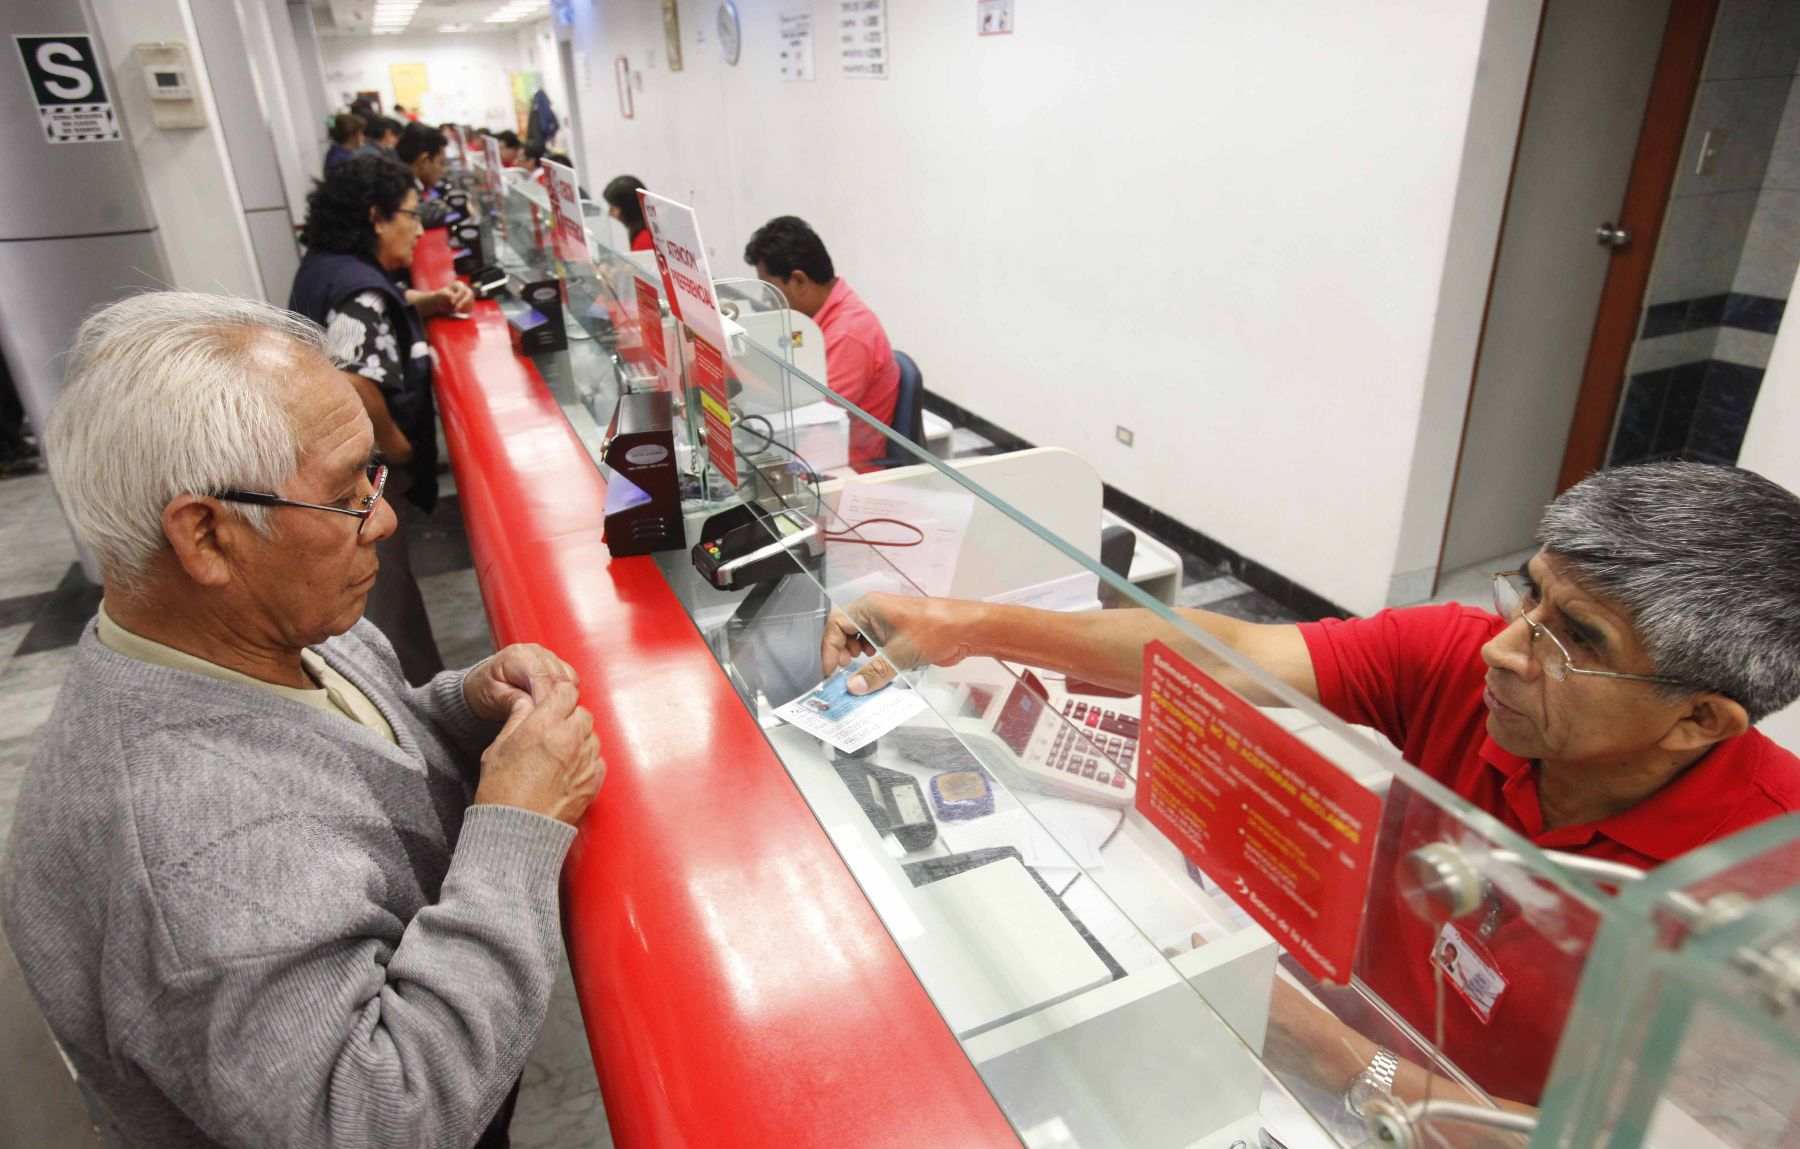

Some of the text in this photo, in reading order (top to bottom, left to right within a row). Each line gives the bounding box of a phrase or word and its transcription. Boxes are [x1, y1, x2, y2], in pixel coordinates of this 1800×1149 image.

[36, 42, 93, 100] S
[1154, 654, 1192, 688] Estimado
[1210, 723, 1223, 739] NO
[1226, 735, 1237, 750] SE
[1300, 792, 1361, 844] RECLAMOS
[1249, 891, 1278, 921] Banco
[1277, 918, 1290, 933] de
[1290, 928, 1301, 944] la
